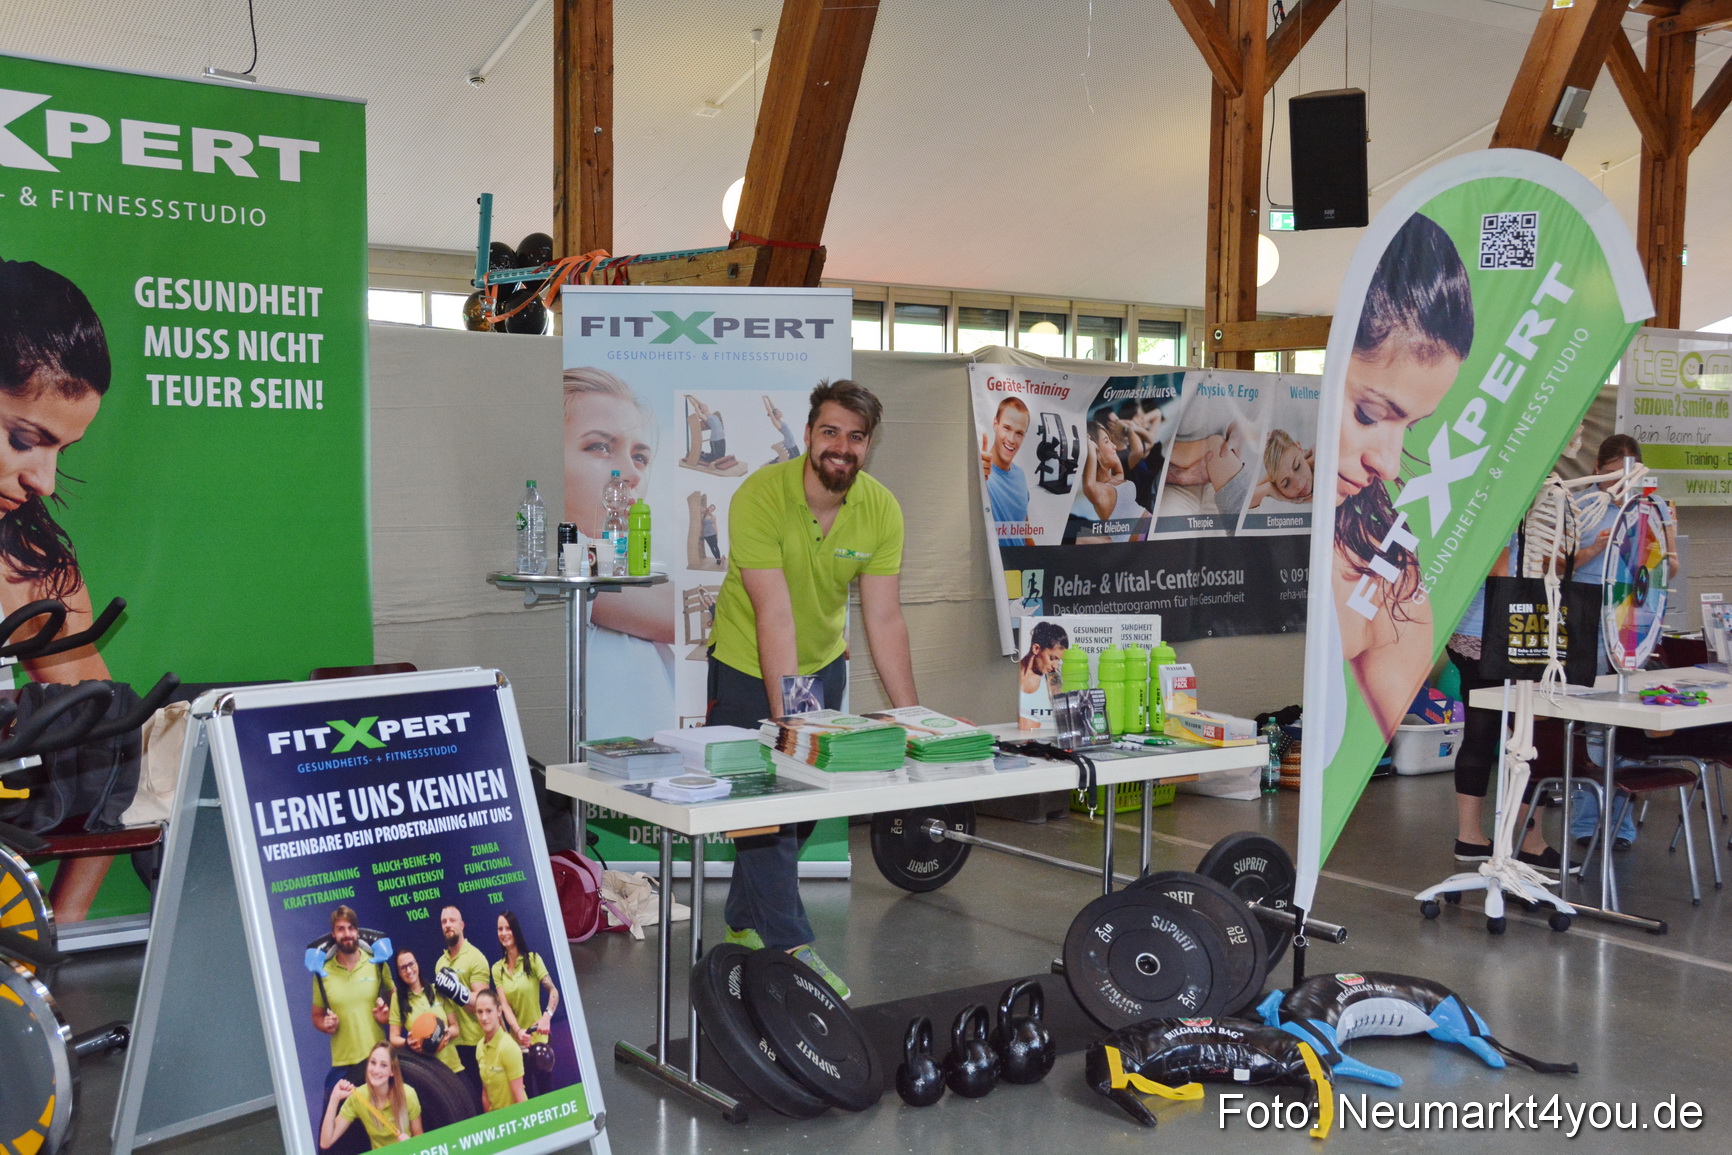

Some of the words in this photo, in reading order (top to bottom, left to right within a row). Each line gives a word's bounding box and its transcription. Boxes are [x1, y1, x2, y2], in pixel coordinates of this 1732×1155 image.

[19, 186, 38, 207] &
[51, 189, 267, 227] FITNESSSTUDIO
[134, 276, 323, 317] GESUNDHEIT
[580, 310, 834, 344] FITXPERT
[144, 325, 230, 360] MUSS
[238, 330, 324, 364] NICHT
[607, 350, 697, 361] GESUNDHEITS-
[701, 351, 709, 361] &
[714, 351, 808, 362] FITNESSSTUDIO
[146, 374, 243, 408] TEUER
[250, 377, 324, 410] SEIN!
[986, 376, 1070, 400] Geräte-Training
[1228, 384, 1235, 397] &
[1238, 384, 1259, 401] Ergo
[1290, 386, 1321, 400] Wellne
[1488, 467, 1504, 480] &
[1498, 327, 1590, 463] FITNESSSTUDIO
[1344, 260, 1575, 621] FITXPERT
[1633, 424, 1659, 443] Dein
[1665, 425, 1693, 444] Team
[1696, 427, 1712, 445] für
[1685, 451, 1719, 469] Training
[1010, 524, 1044, 536] bleiben
[1092, 522, 1102, 534] Fit
[1104, 521, 1130, 534] bleiben
[1267, 516, 1304, 528] Entspannen
[1053, 574, 1096, 597] Reha-
[1100, 573, 1111, 594] &
[1200, 566, 1245, 587] Sossau
[1053, 603, 1071, 616] Das
[1072, 598, 1172, 616] Komplettprogramm
[1174, 596, 1188, 608] für
[1199, 592, 1245, 605] Gesundheit
[1509, 603, 1534, 613] KEIN
[1073, 626, 1113, 634] GESUNDHEIT
[267, 711, 471, 755] FITXPERT
[1203, 730, 1215, 738] PACK
[297, 758, 373, 774] GESUNDHEITS-
[376, 755, 383, 763] +
[385, 745, 458, 762] FITNESSSTUDIO
[255, 791, 346, 837] LERNE
[348, 782, 405, 822] UNS
[407, 768, 508, 813] KENNEN
[263, 833, 344, 862] VEREINBARE
[344, 829, 374, 849] DEIN
[375, 814, 467, 844] PROBETRAINING
[468, 810, 489, 828] MIT
[490, 806, 513, 823] UNS
[470, 841, 500, 857] ZUMBA
[372, 852, 442, 875] BAUCH-BEINE-PO
[464, 856, 513, 875] FUNCTIONAL
[906, 858, 939, 873] SUPRFIT
[1233, 856, 1268, 875] SUPRFIT
[270, 867, 361, 894] AUSDAUERTRAINING
[377, 876, 406, 892] BAUCH
[407, 868, 445, 888] INTENSIV
[458, 870, 527, 893] DEHNUNGSZIRKEL
[283, 886, 355, 910] KRAFTTRAINING
[389, 894, 412, 908] KICK-
[413, 887, 441, 902] BOXEN
[488, 892, 504, 905] TRX
[406, 907, 430, 922] YOGA
[1151, 915, 1197, 952] SUPRFIT
[1226, 925, 1244, 935] 20
[1229, 934, 1248, 945] KG
[793, 973, 836, 1012] SUPRFIT
[1163, 1026, 1216, 1041] BULGARIAN
[796, 1040, 841, 1079] SUPRFIT
[459, 1100, 578, 1151] WWW.FIT-XPERT.DE
